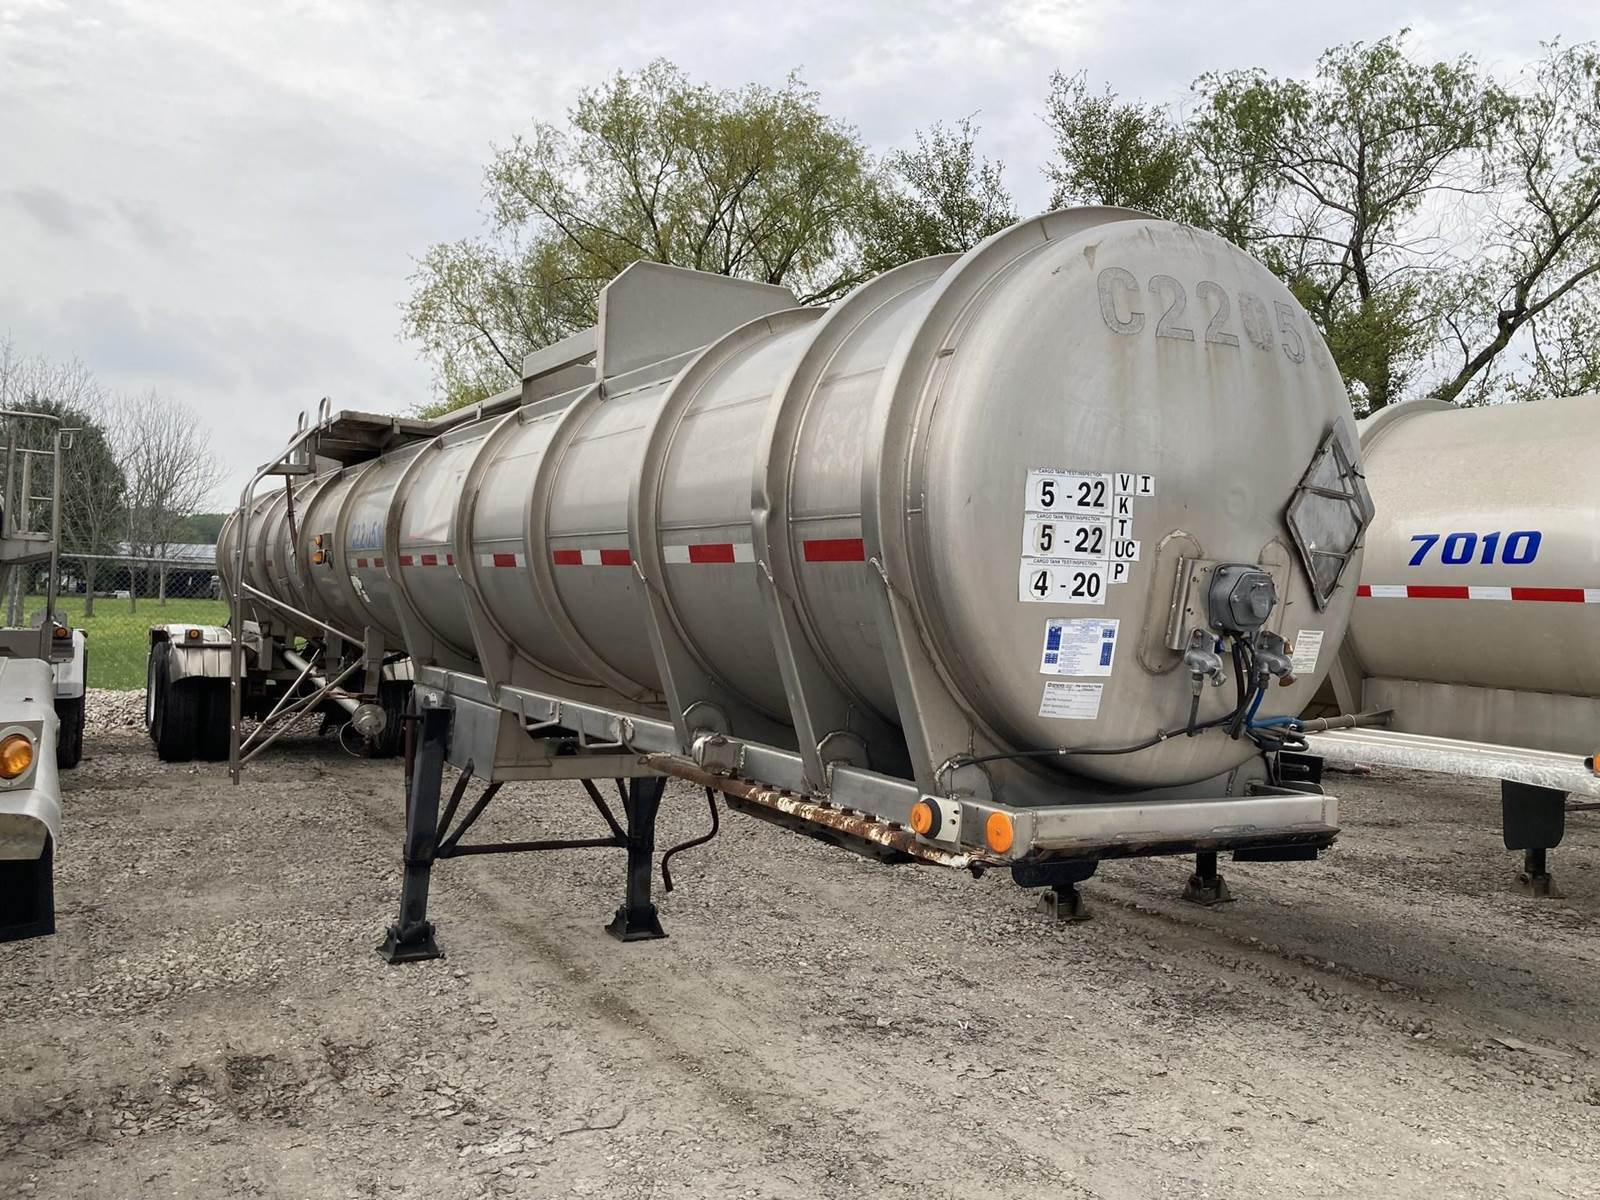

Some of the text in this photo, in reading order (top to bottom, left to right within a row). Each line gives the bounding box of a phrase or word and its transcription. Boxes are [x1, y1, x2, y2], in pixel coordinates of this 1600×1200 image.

[1120, 474, 1130, 492] V
[1041, 481, 1055, 507] 5
[1077, 481, 1105, 508] 22
[1119, 496, 1129, 514] K
[1118, 519, 1128, 537] T
[1040, 524, 1053, 552] 5
[1074, 527, 1103, 554] 22
[1115, 541, 1136, 558] UC
[1407, 530, 1543, 567] 7010
[1114, 563, 1124, 580] P
[1033, 571, 1048, 596] 4
[1071, 572, 1101, 598] 20
